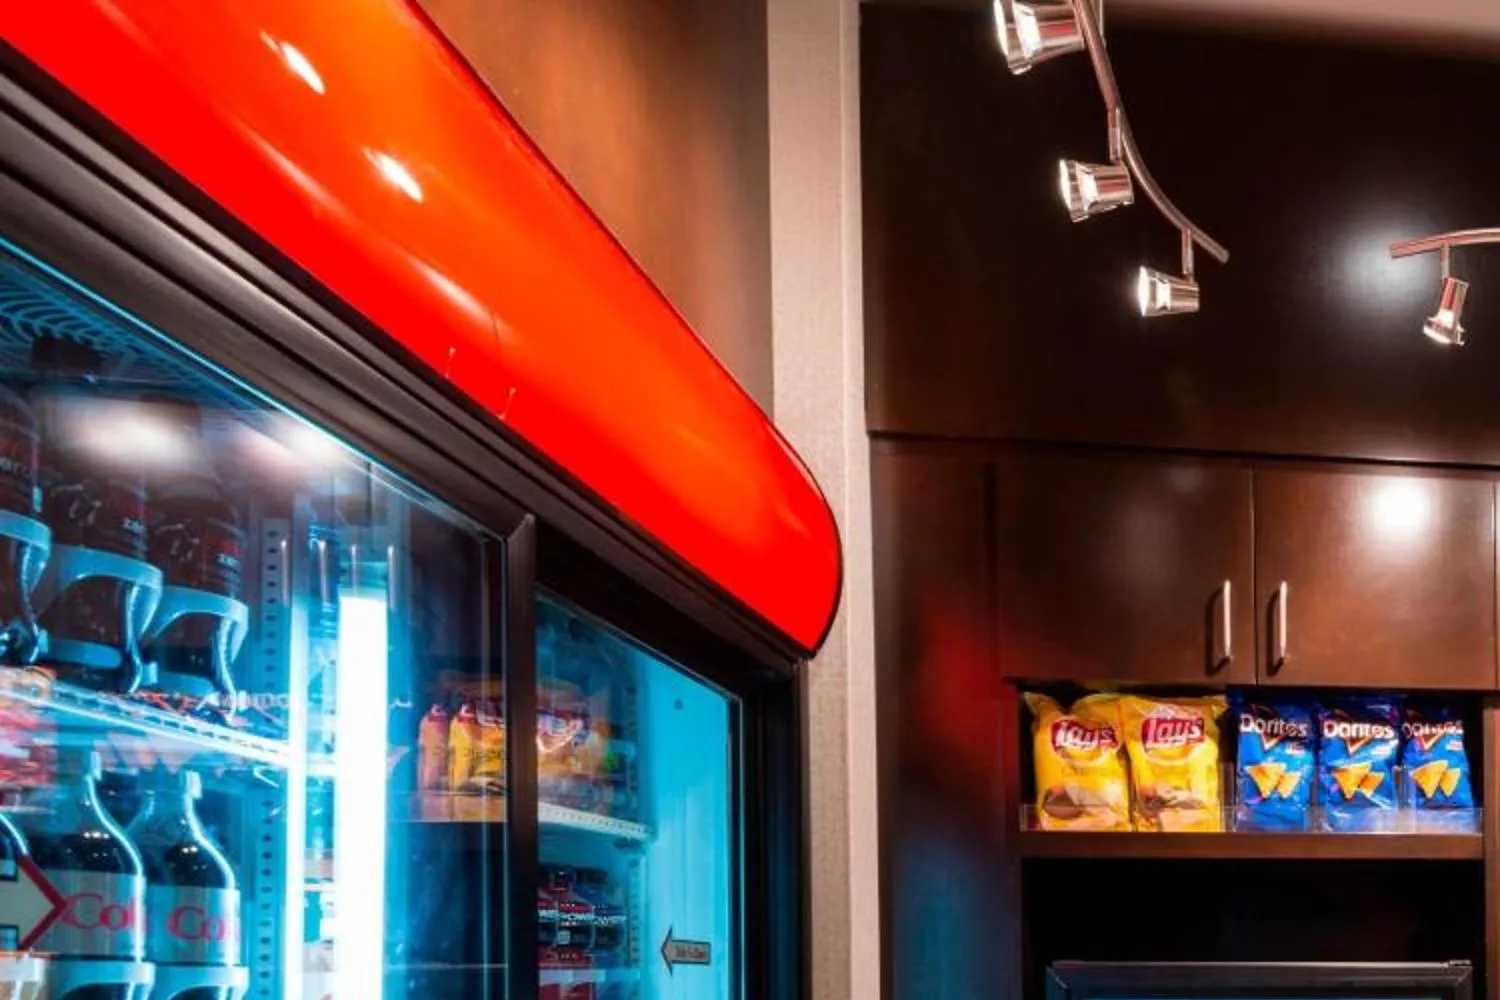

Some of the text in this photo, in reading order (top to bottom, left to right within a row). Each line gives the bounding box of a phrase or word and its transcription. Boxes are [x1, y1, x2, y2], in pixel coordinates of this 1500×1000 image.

[1144, 717, 1203, 749] Lay's
[1240, 713, 1309, 738] Doritos
[1322, 719, 1395, 740] Doritos
